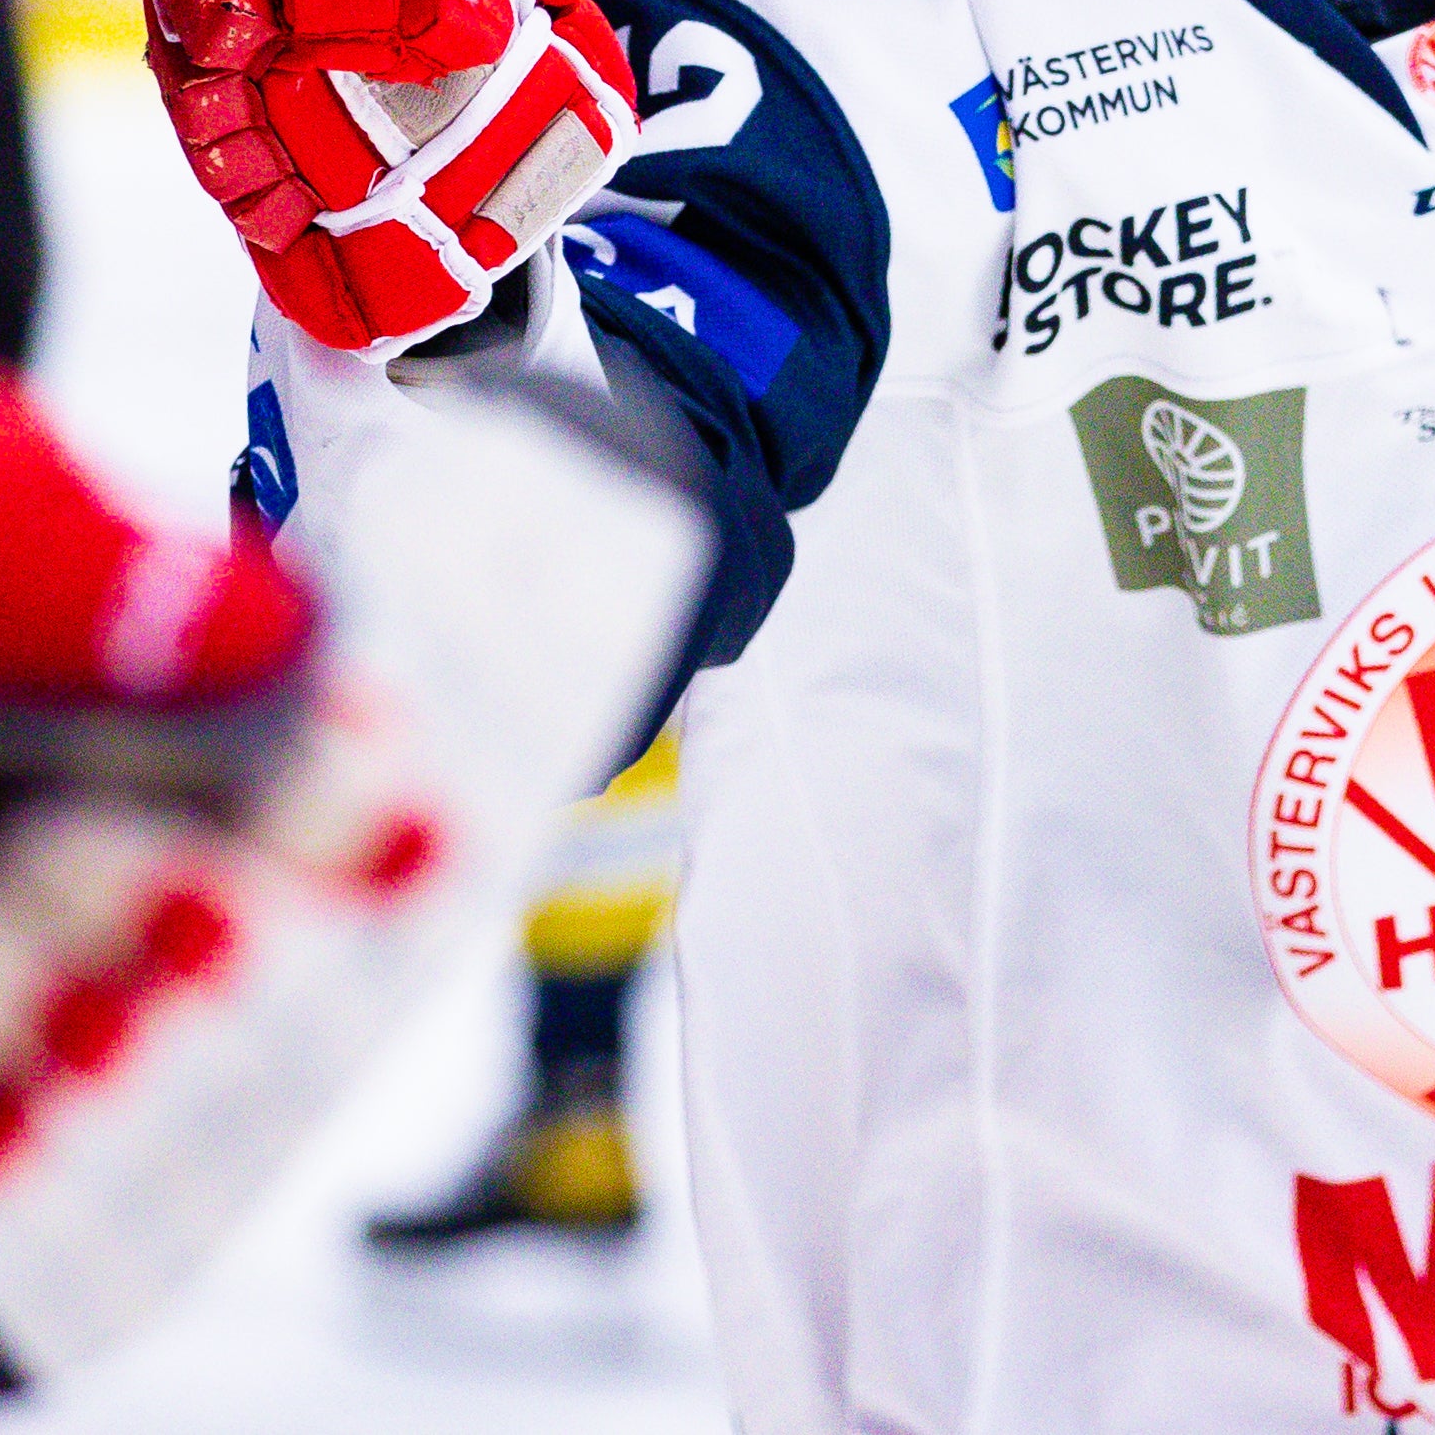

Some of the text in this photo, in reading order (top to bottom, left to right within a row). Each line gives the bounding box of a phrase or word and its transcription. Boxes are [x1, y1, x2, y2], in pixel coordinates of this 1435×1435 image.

[999, 25, 1214, 102] VÄSTERVIKS
[1012, 76, 1179, 147] KOMMUN
[1003, 187, 1252, 320] OCKEY
[1023, 254, 1273, 355] STORE.
[1270, 611, 1415, 977] VÄSTERVIKS
